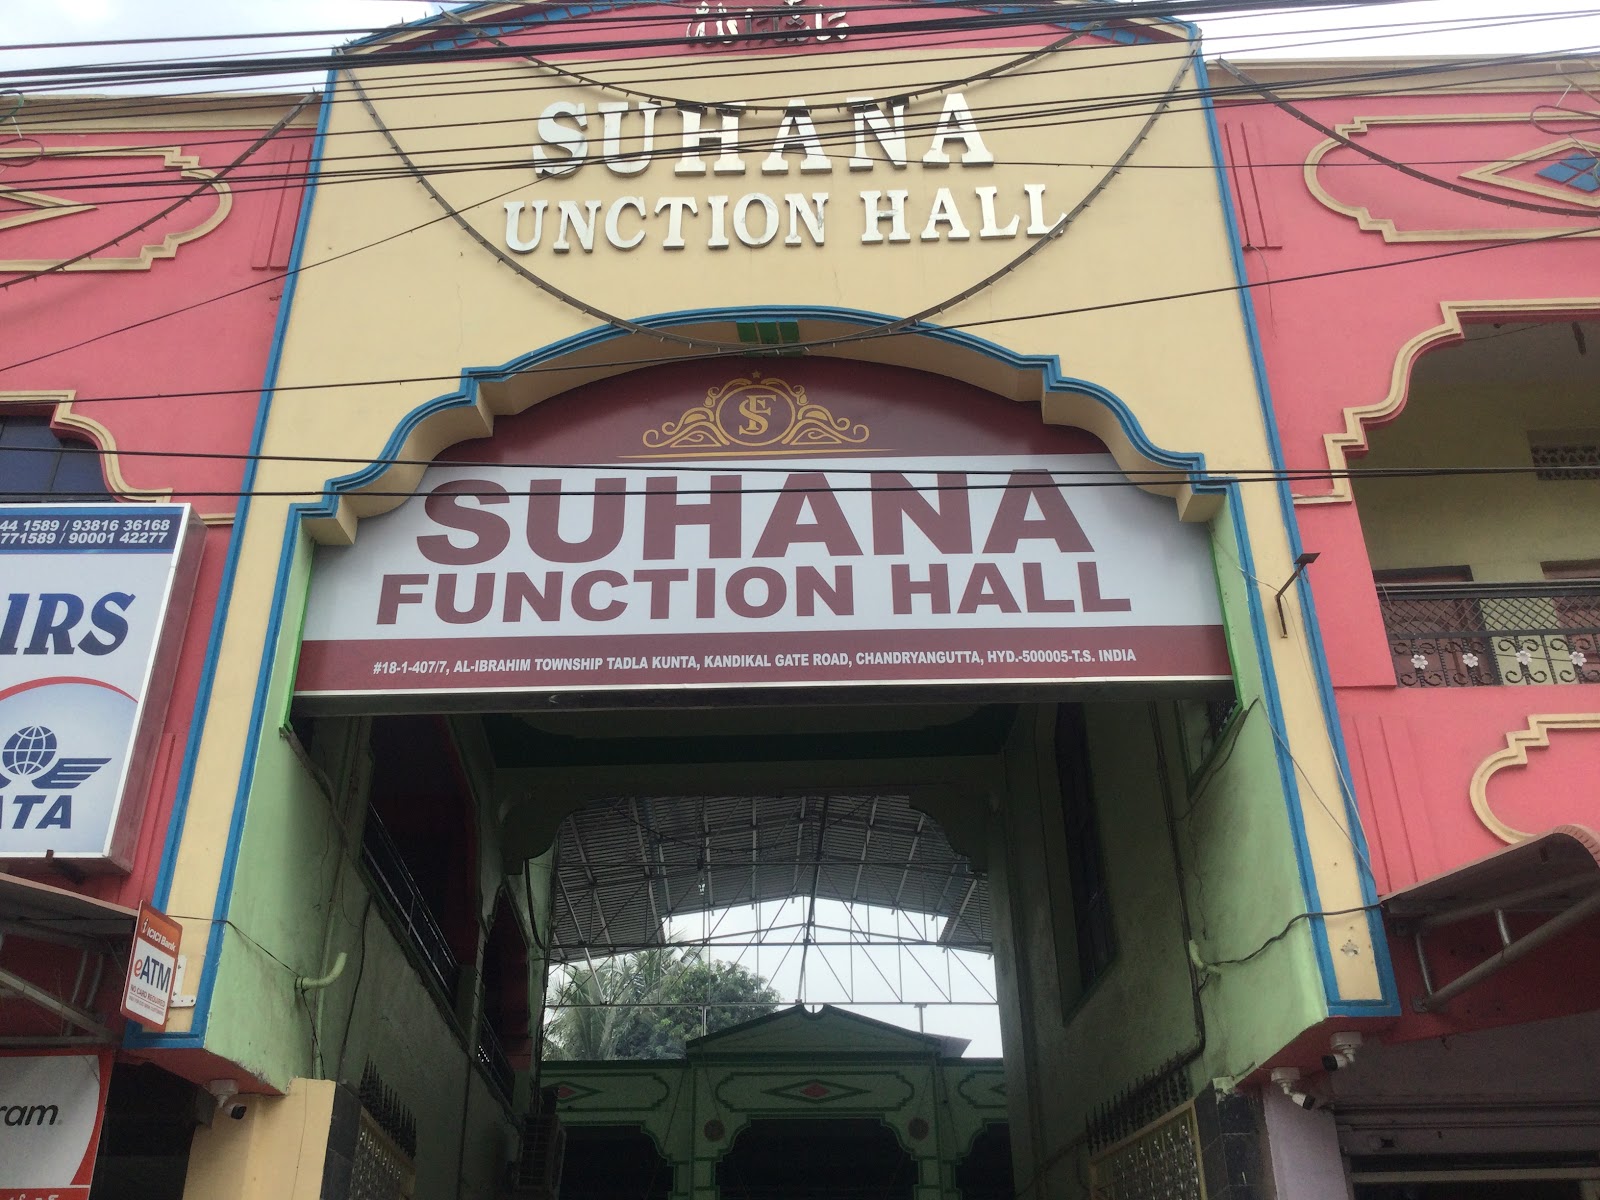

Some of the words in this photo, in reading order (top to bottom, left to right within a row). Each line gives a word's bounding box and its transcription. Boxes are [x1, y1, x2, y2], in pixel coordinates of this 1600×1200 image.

[532, 92, 995, 178] SUHANA
[504, 192, 829, 255] UNCTION
[860, 183, 1067, 245] HALL
[23, 519, 60, 531] 1589
[72, 519, 120, 531] 93816
[123, 519, 171, 531] 36168
[416, 468, 1094, 566] SUHANA
[0, 532, 57, 544] 771589
[68, 532, 115, 544] 90001
[119, 532, 169, 544] 42277
[376, 565, 855, 626] FUNCTION
[890, 561, 1132, 615] HALL
[373, 660, 450, 675] #18-1-407/7,
[453, 658, 531, 673] AL-IBRAHIM
[535, 657, 603, 671] TOWNSHIP
[607, 656, 649, 670] TADLA
[652, 655, 701, 671] KUNTA,
[704, 654, 771, 668] KANDIKAL
[775, 653, 809, 667] GATE
[813, 652, 852, 668] ROAD,
[856, 650, 984, 665] CHANDRYANGUTTA,
[987, 649, 1096, 663] HYD.-500005-T.S.
[1099, 648, 1136, 662] INDIA
[0, 795, 72, 829] TA
[147, 927, 161, 944] ICICI
[161, 935, 177, 952] Bank
[134, 955, 171, 993] eATM
